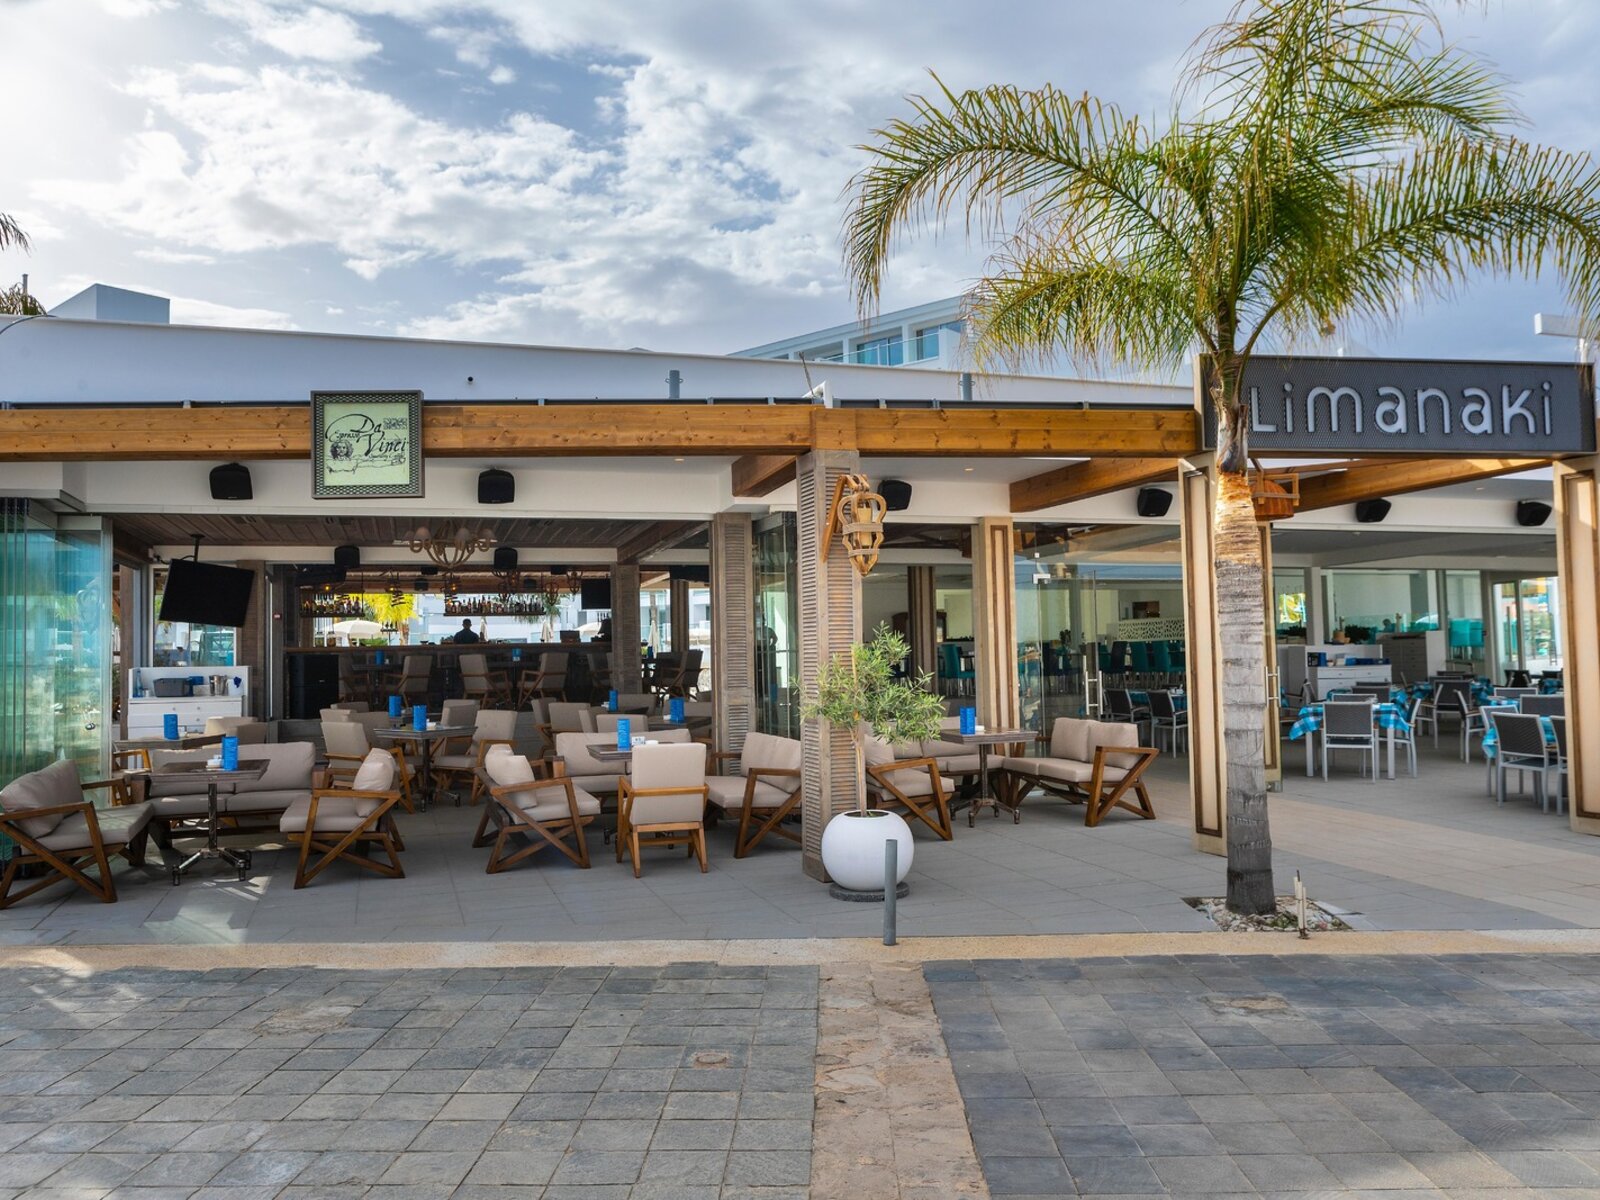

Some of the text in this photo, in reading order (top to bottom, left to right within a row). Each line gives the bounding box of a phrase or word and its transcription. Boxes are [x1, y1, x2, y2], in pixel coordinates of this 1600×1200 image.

[1250, 380, 1553, 436] Limanaki
[325, 413, 382, 439] Da
[356, 431, 407, 457] Vinci
